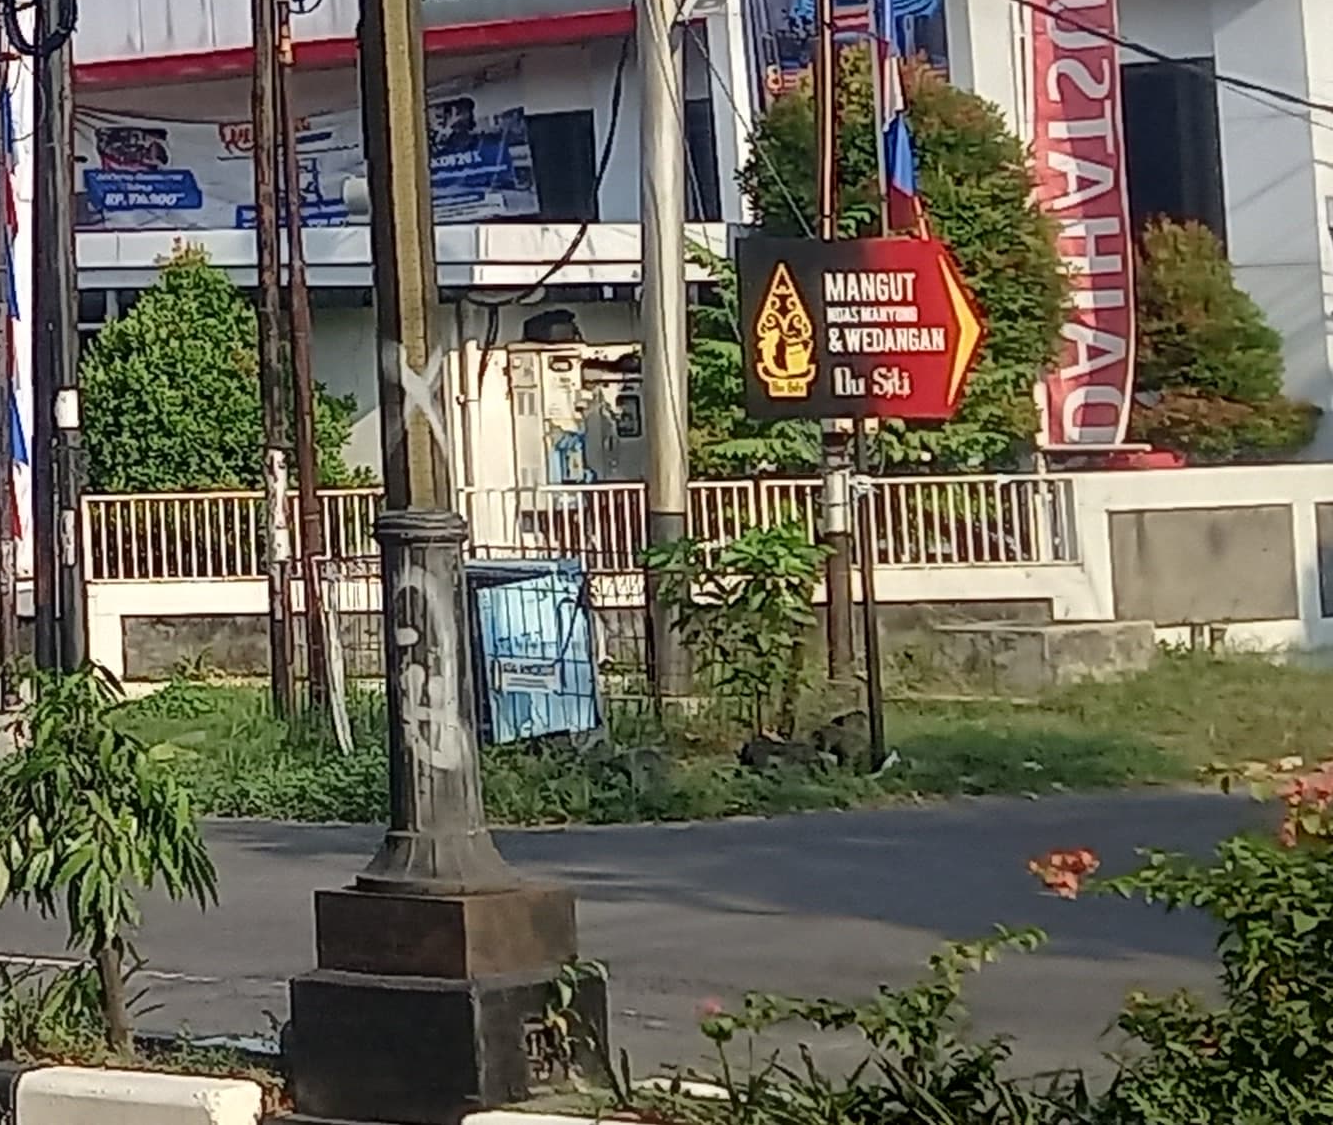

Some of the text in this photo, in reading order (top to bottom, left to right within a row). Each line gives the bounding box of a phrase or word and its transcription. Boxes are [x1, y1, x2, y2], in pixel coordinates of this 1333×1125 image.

[823, 272, 917, 302] MANGUT
[828, 327, 946, 353] & WEDANGAN
[872, 366, 912, 400] Siti
